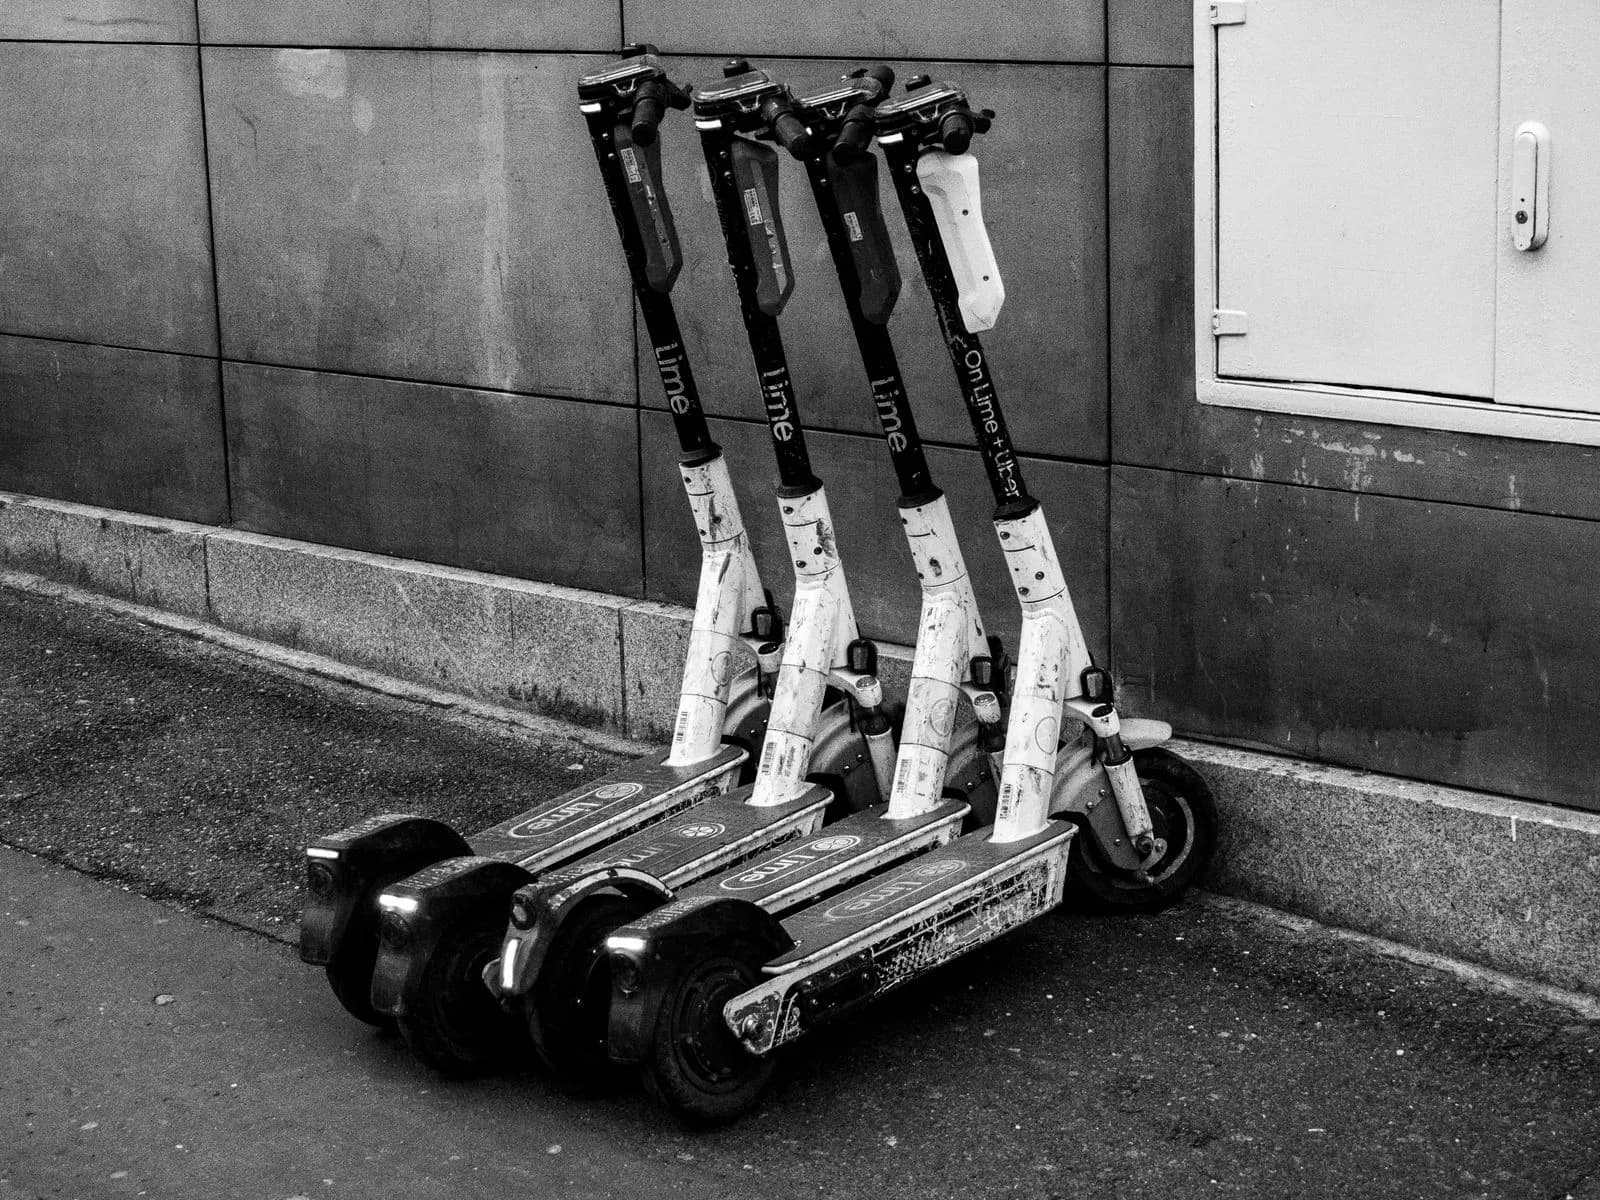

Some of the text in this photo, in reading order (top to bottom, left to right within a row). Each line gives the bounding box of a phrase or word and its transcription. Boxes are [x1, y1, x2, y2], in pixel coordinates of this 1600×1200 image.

[655, 342, 690, 414] Lime
[763, 367, 794, 441] Lime
[871, 375, 907, 452] Lime
[965, 350, 1020, 497] On Lime + Uber
[527, 801, 600, 831] Lime
[739, 854, 817, 883] Lime
[847, 880, 923, 910] Lime
